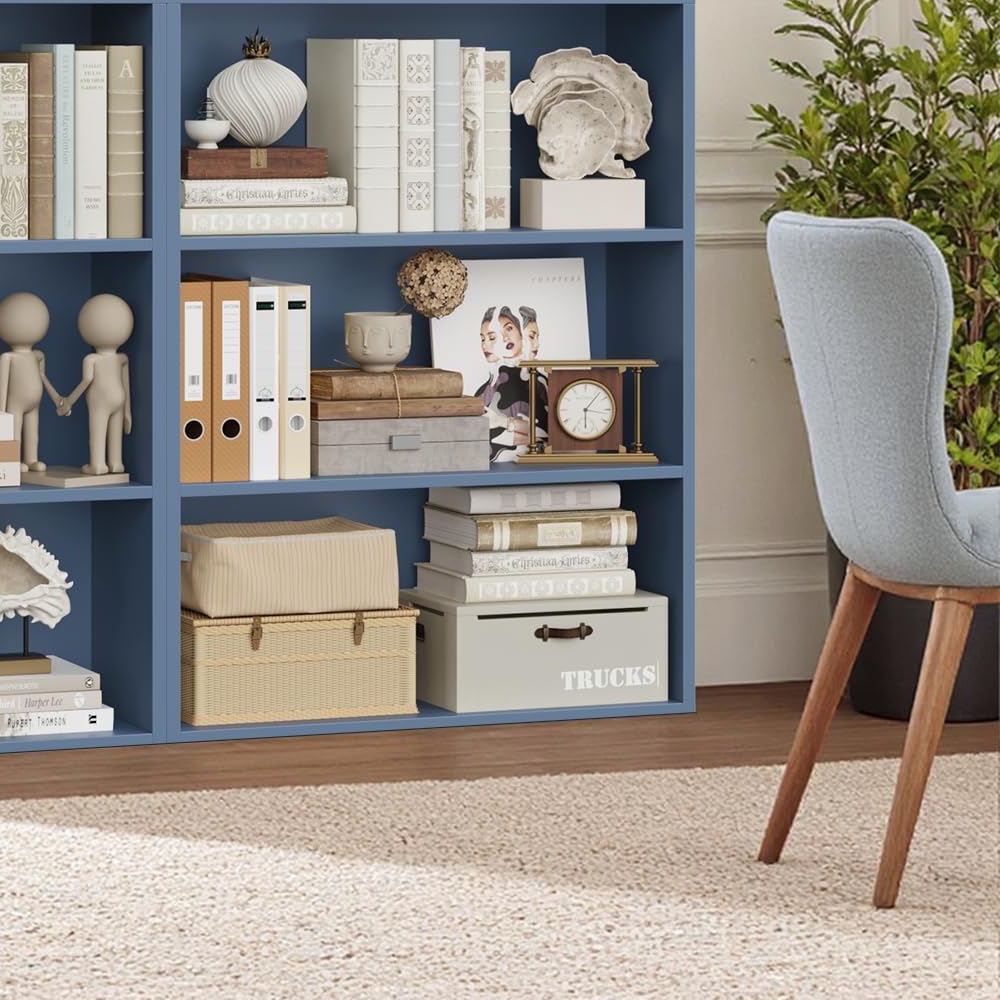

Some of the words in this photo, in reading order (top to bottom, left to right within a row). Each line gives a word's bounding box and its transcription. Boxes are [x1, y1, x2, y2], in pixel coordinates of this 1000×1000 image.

[119, 60, 136, 78] A
[561, 665, 656, 690] TRUCKS
[24, 697, 48, 710] Harper
[51, 696, 63, 706] Lee
[8, 718, 32, 728] RUPERT
[38, 716, 66, 726] THOMSON
